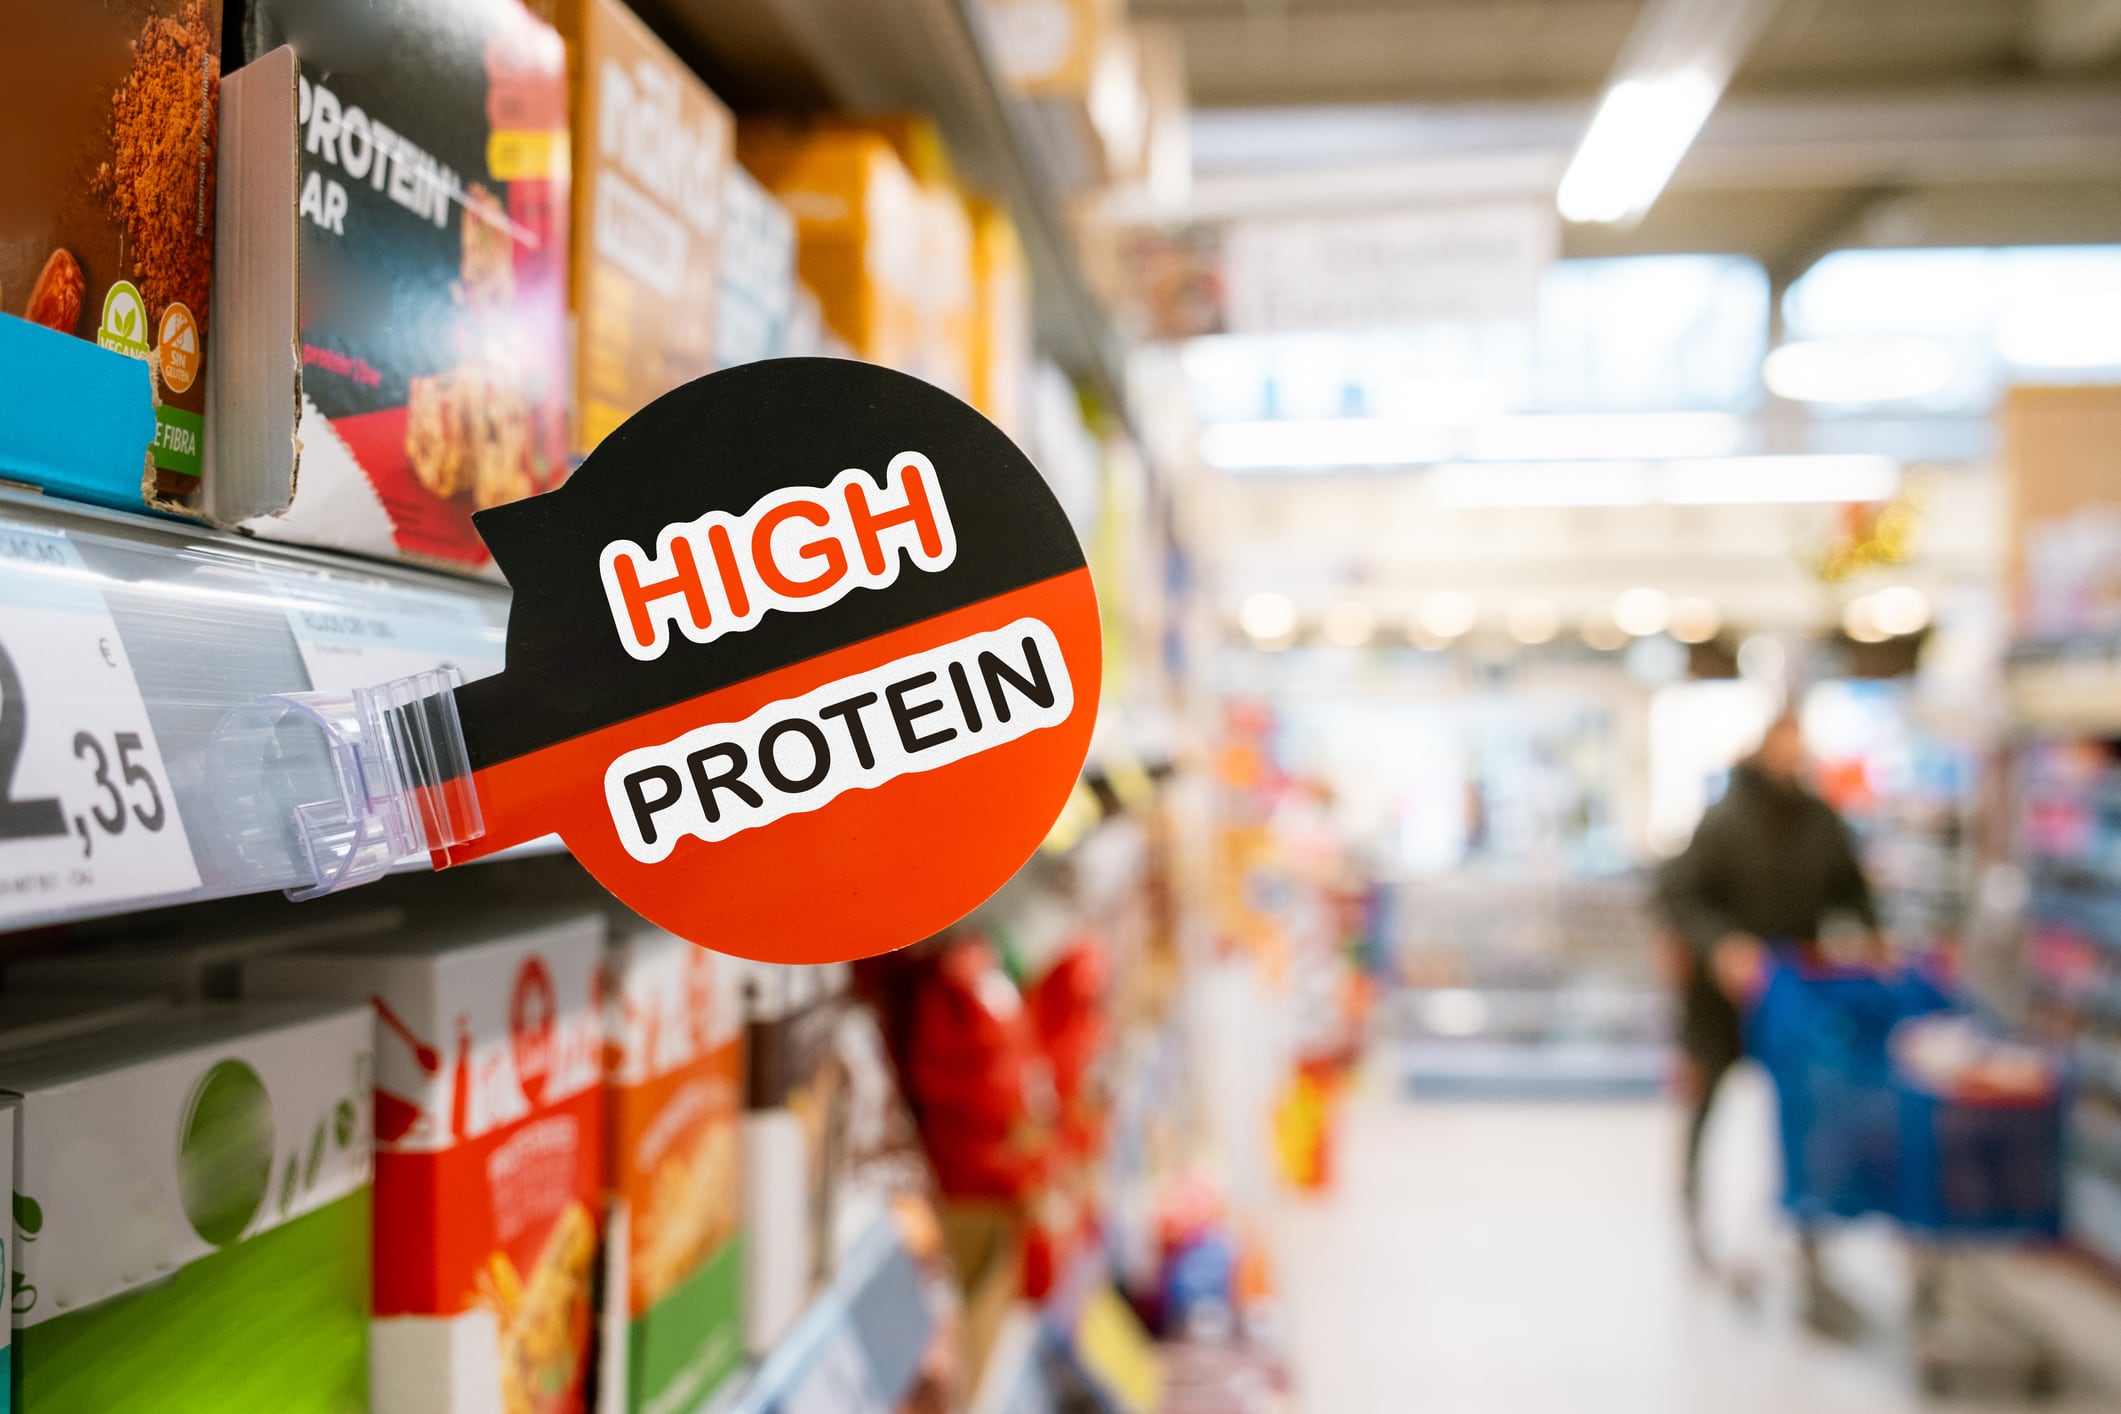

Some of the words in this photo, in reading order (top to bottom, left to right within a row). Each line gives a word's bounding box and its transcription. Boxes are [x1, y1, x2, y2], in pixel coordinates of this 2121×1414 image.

[196, 161, 206, 235] Sugerencia
[201, 53, 210, 138] presentación
[165, 364, 191, 384] GLUTEN
[170, 349, 187, 369] SIN
[162, 424, 197, 457] FIBRA
[612, 464, 944, 648] HIGH
[623, 636, 1056, 845] PROTEIN
